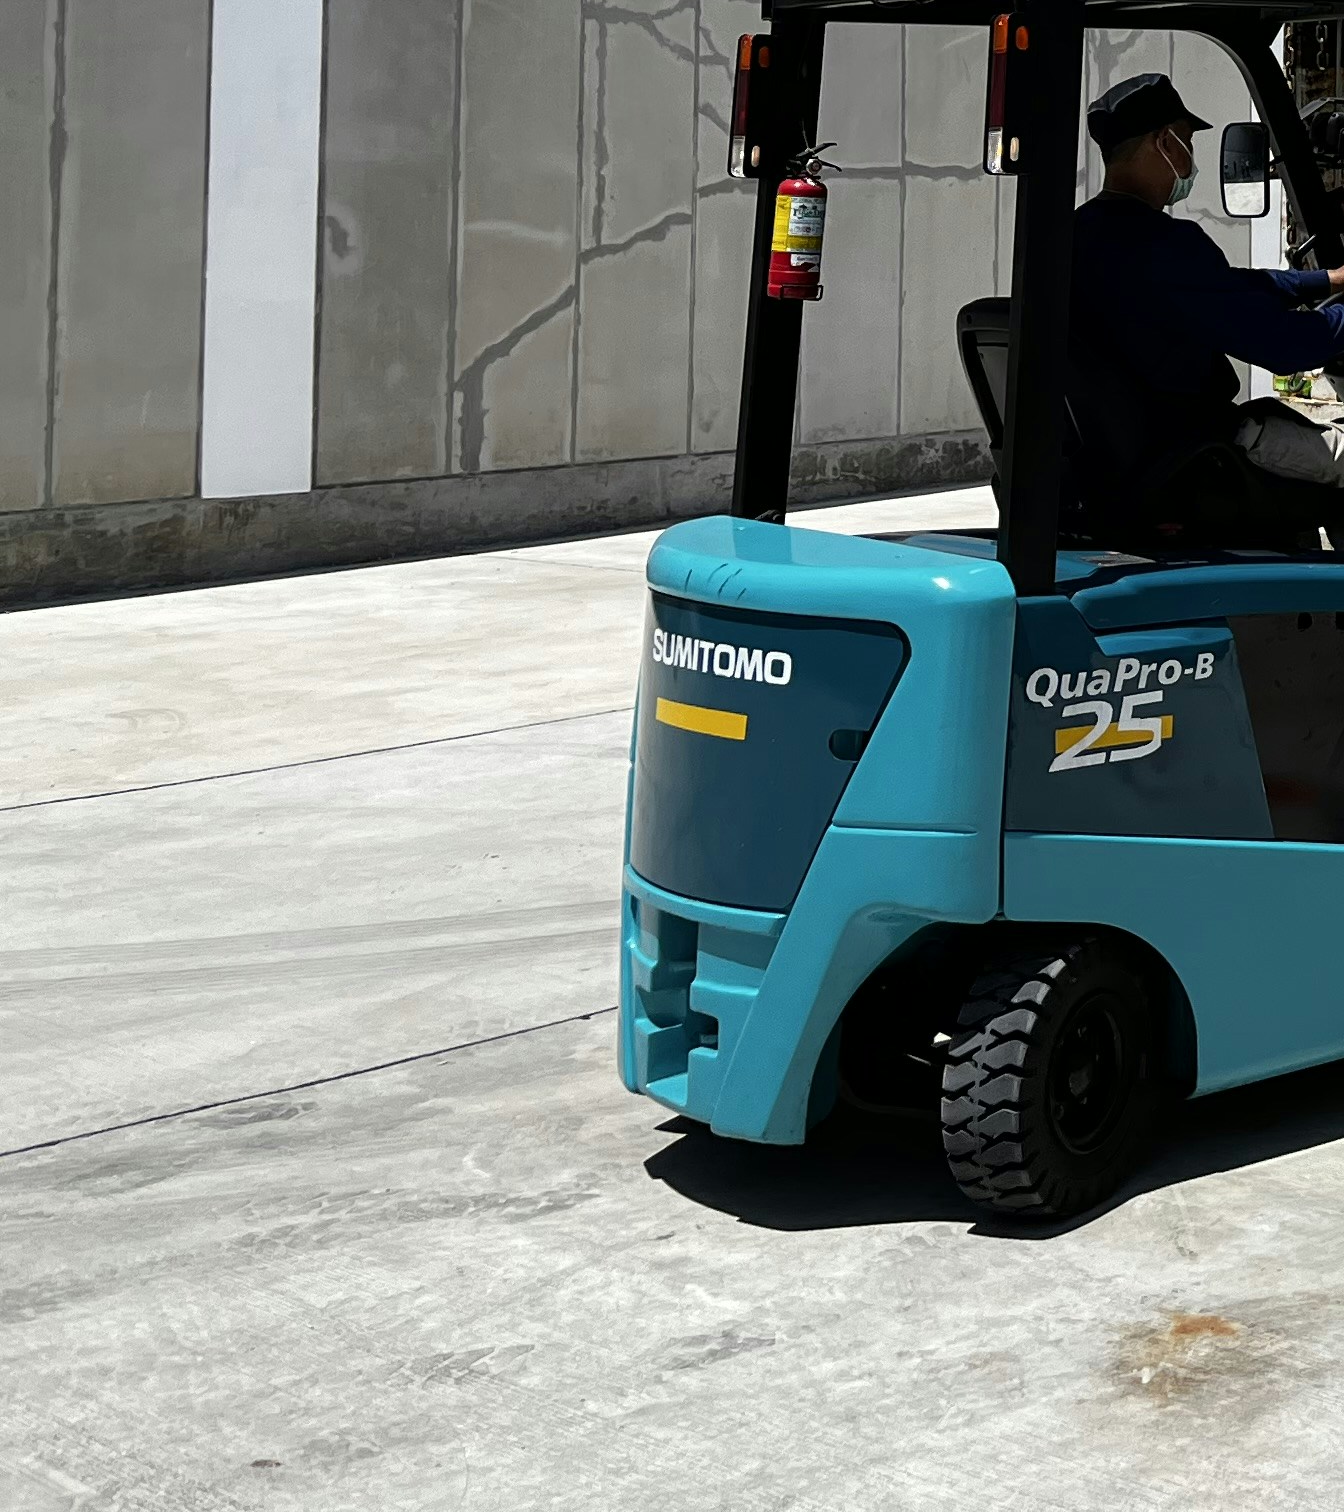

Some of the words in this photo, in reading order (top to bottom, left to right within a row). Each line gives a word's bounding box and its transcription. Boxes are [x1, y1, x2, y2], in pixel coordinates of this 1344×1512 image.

[652, 627, 792, 686] SUMITOMO
[1026, 652, 1215, 708] QuaPro-B
[1048, 690, 1164, 773] 25
